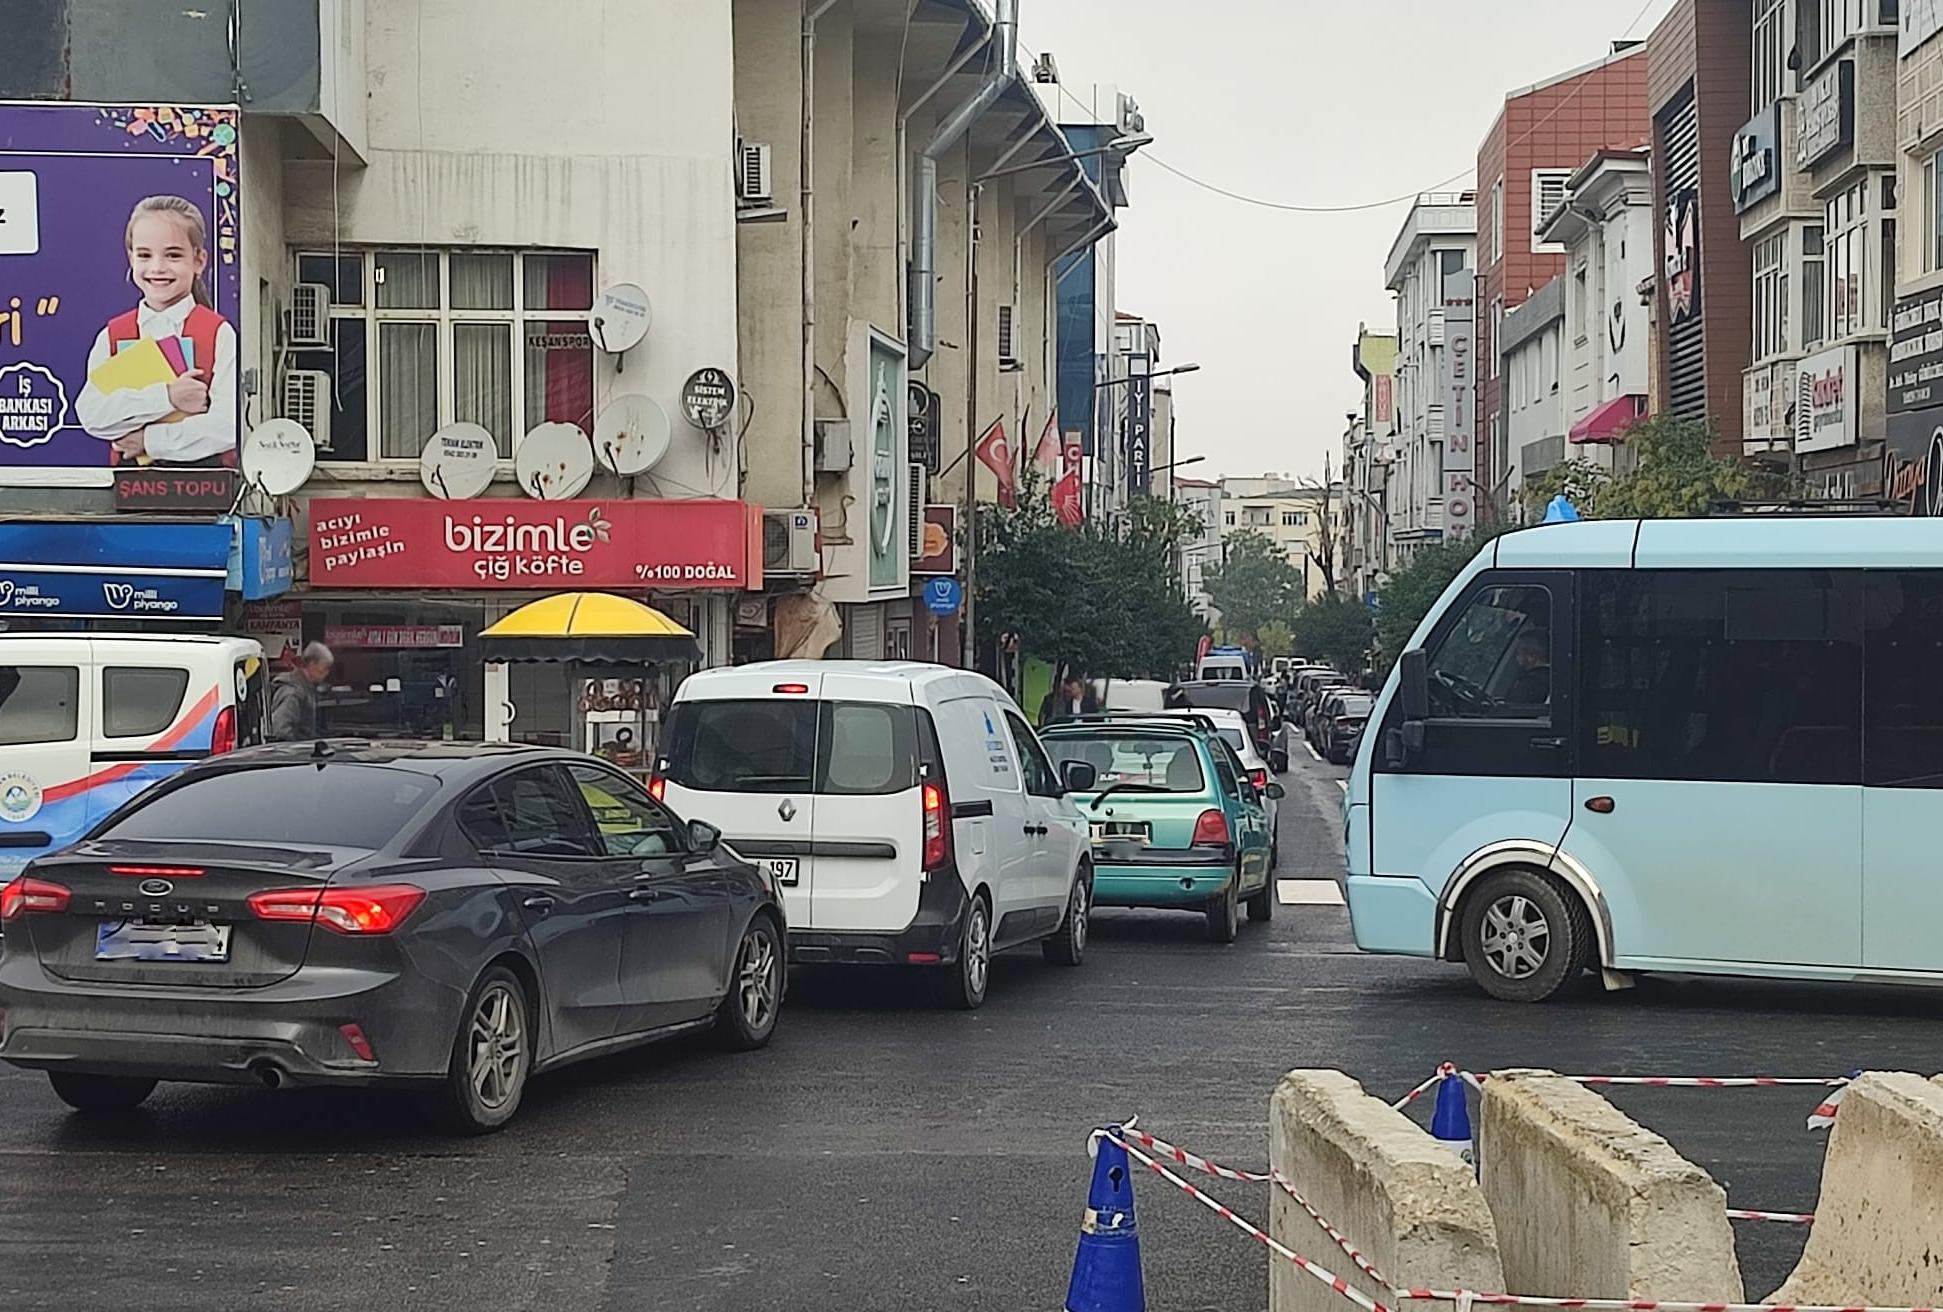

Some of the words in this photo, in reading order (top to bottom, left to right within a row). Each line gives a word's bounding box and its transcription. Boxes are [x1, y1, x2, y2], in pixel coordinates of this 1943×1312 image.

[18, 374, 32, 398] İŞ
[0, 398, 53, 414] BANKASI
[2, 415, 48, 432] ARKASI
[120, 480, 169, 499] ŞANS
[173, 480, 226, 497] TOPU
[316, 513, 361, 533] acıyı
[320, 525, 390, 550] bizimle
[445, 516, 593, 551] bizimle
[325, 540, 405, 572] paylaşın
[473, 555, 510, 580] çiğ
[516, 555, 583, 575] köfte
[635, 564, 680, 579] %100
[684, 561, 736, 579] DOĞAL
[15, 586, 39, 596] milli
[134, 590, 158, 599] milli
[15, 597, 60, 607] piyango
[134, 600, 178, 611] piyango
